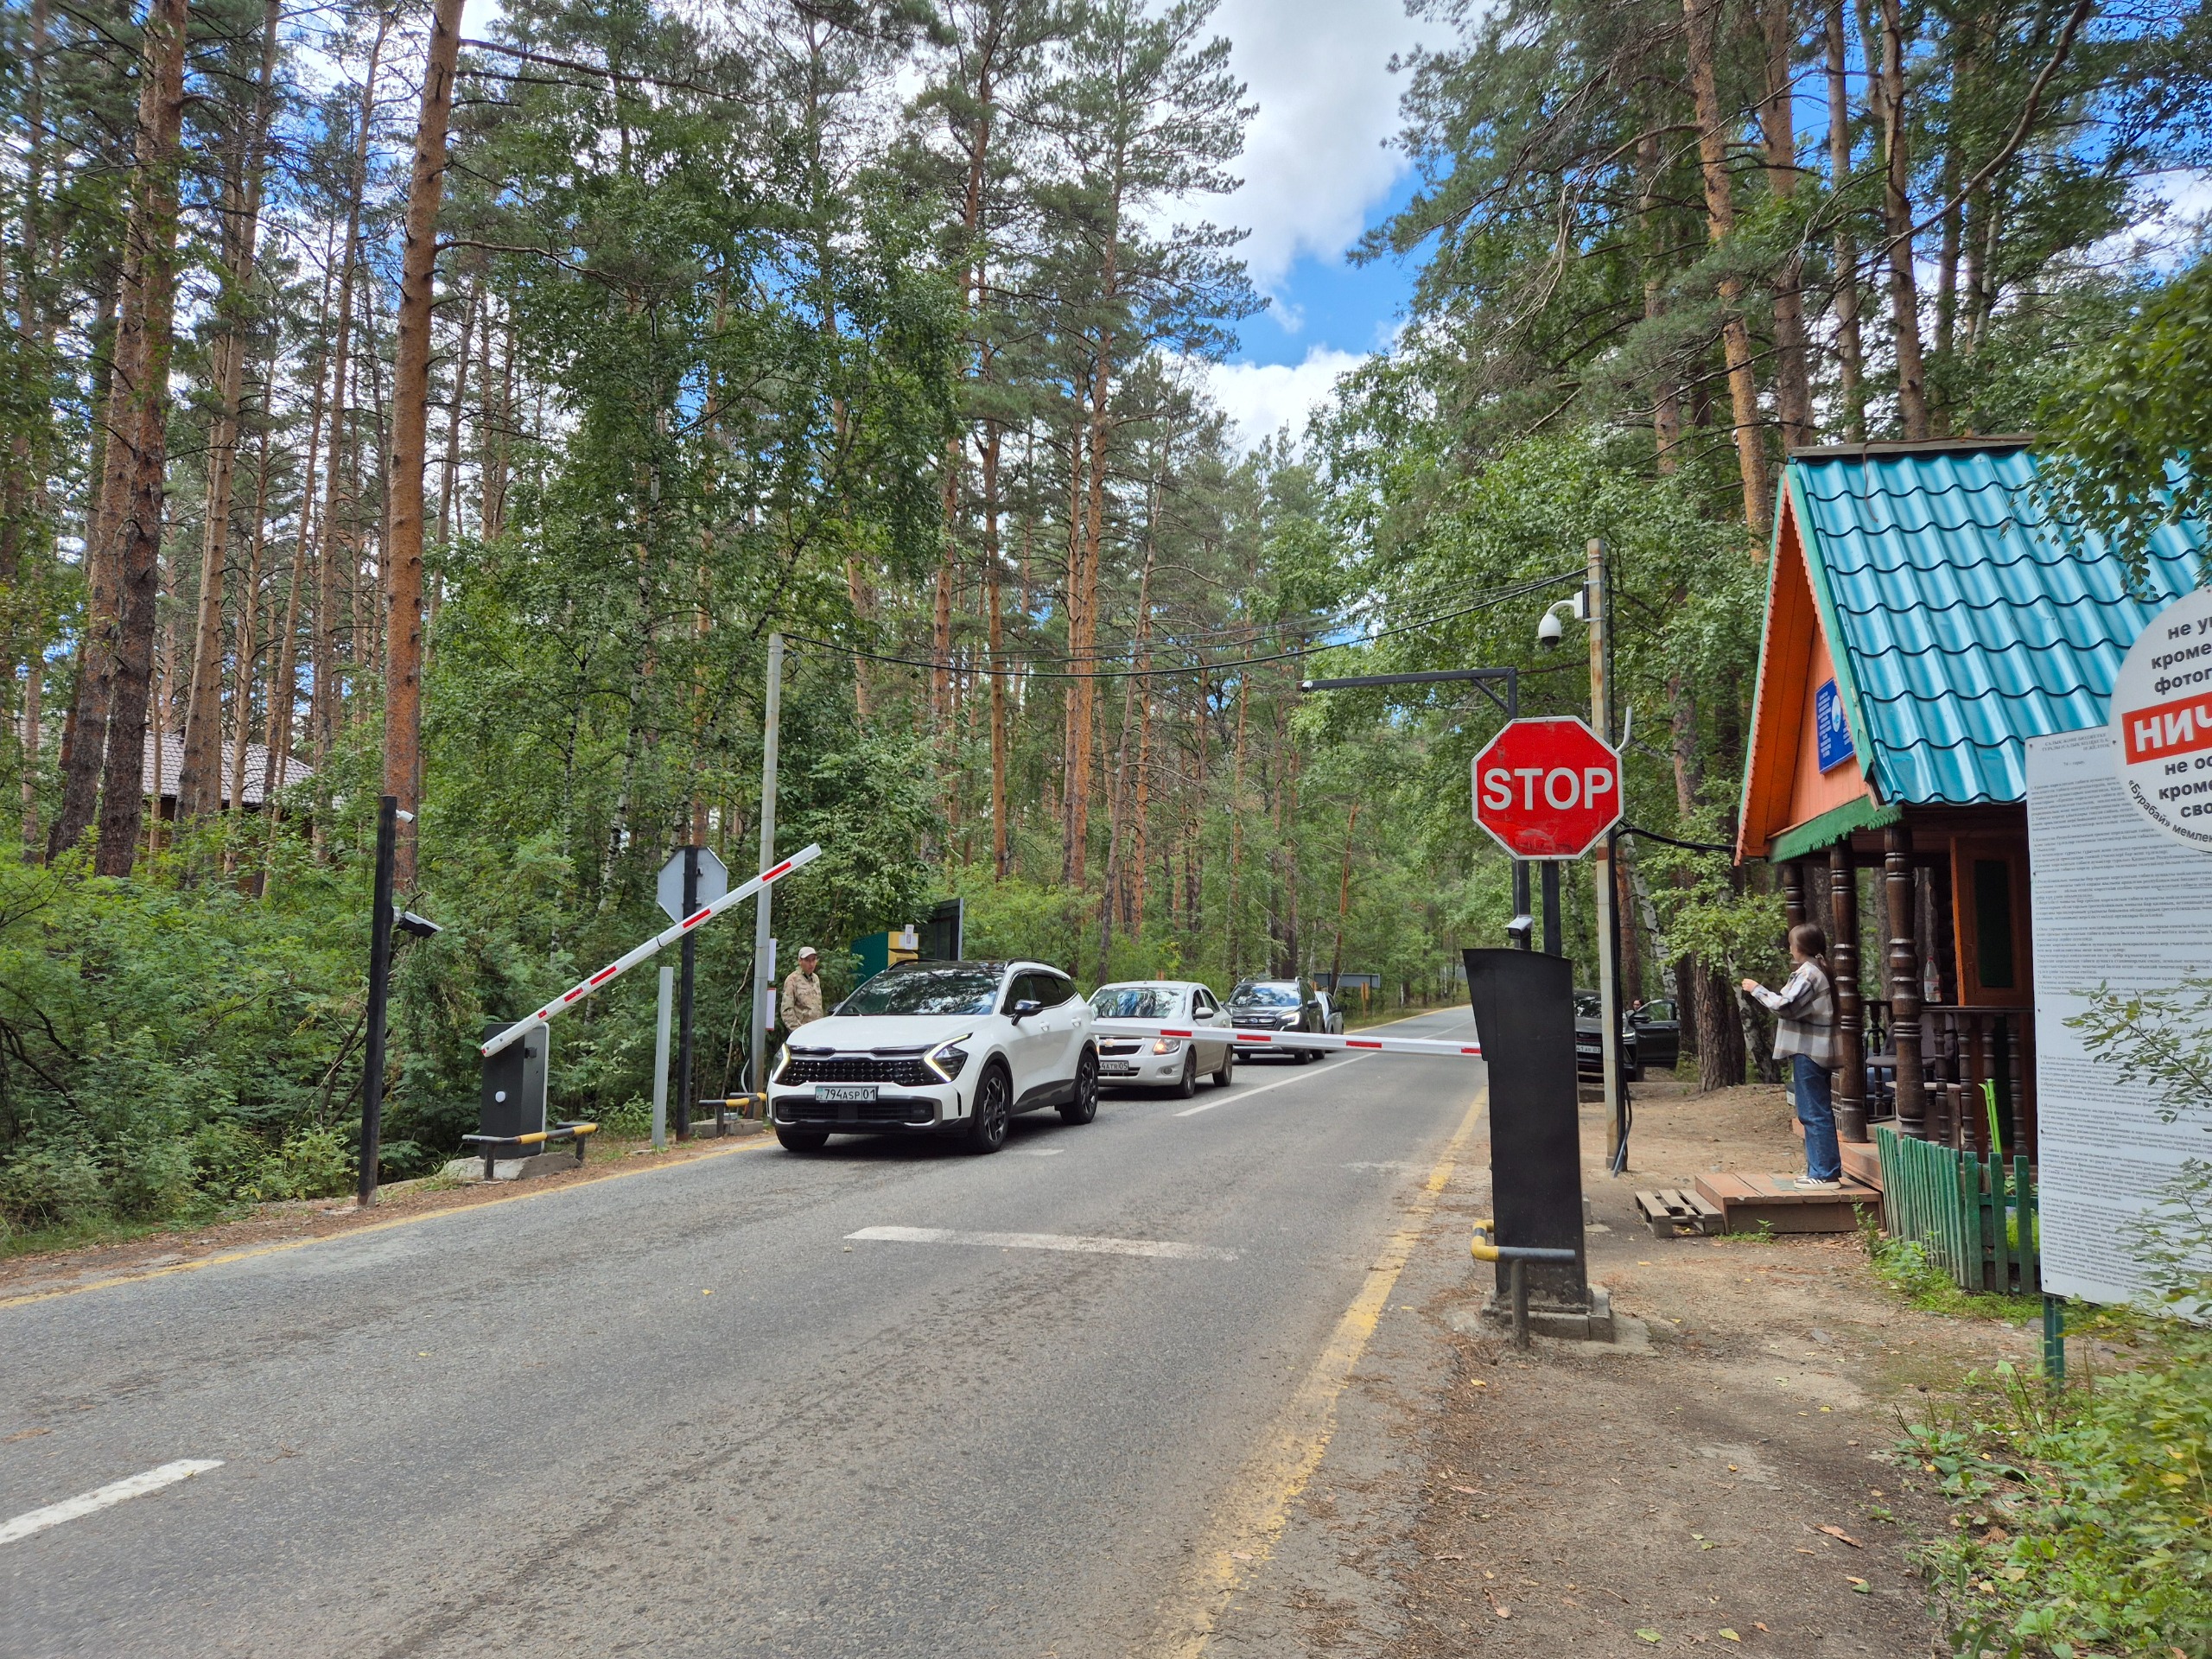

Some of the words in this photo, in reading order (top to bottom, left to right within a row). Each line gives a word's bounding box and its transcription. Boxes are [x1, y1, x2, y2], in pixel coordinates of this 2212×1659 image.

[2167, 623, 2191, 640] не
[2151, 643, 2212, 671] кроме
[2164, 760, 2188, 776] не
[1483, 767, 1613, 810] STOP
[2128, 779, 2171, 828] «Бурабай»
[2180, 802, 2212, 818] сво
[862, 1088, 875, 1100] 01
